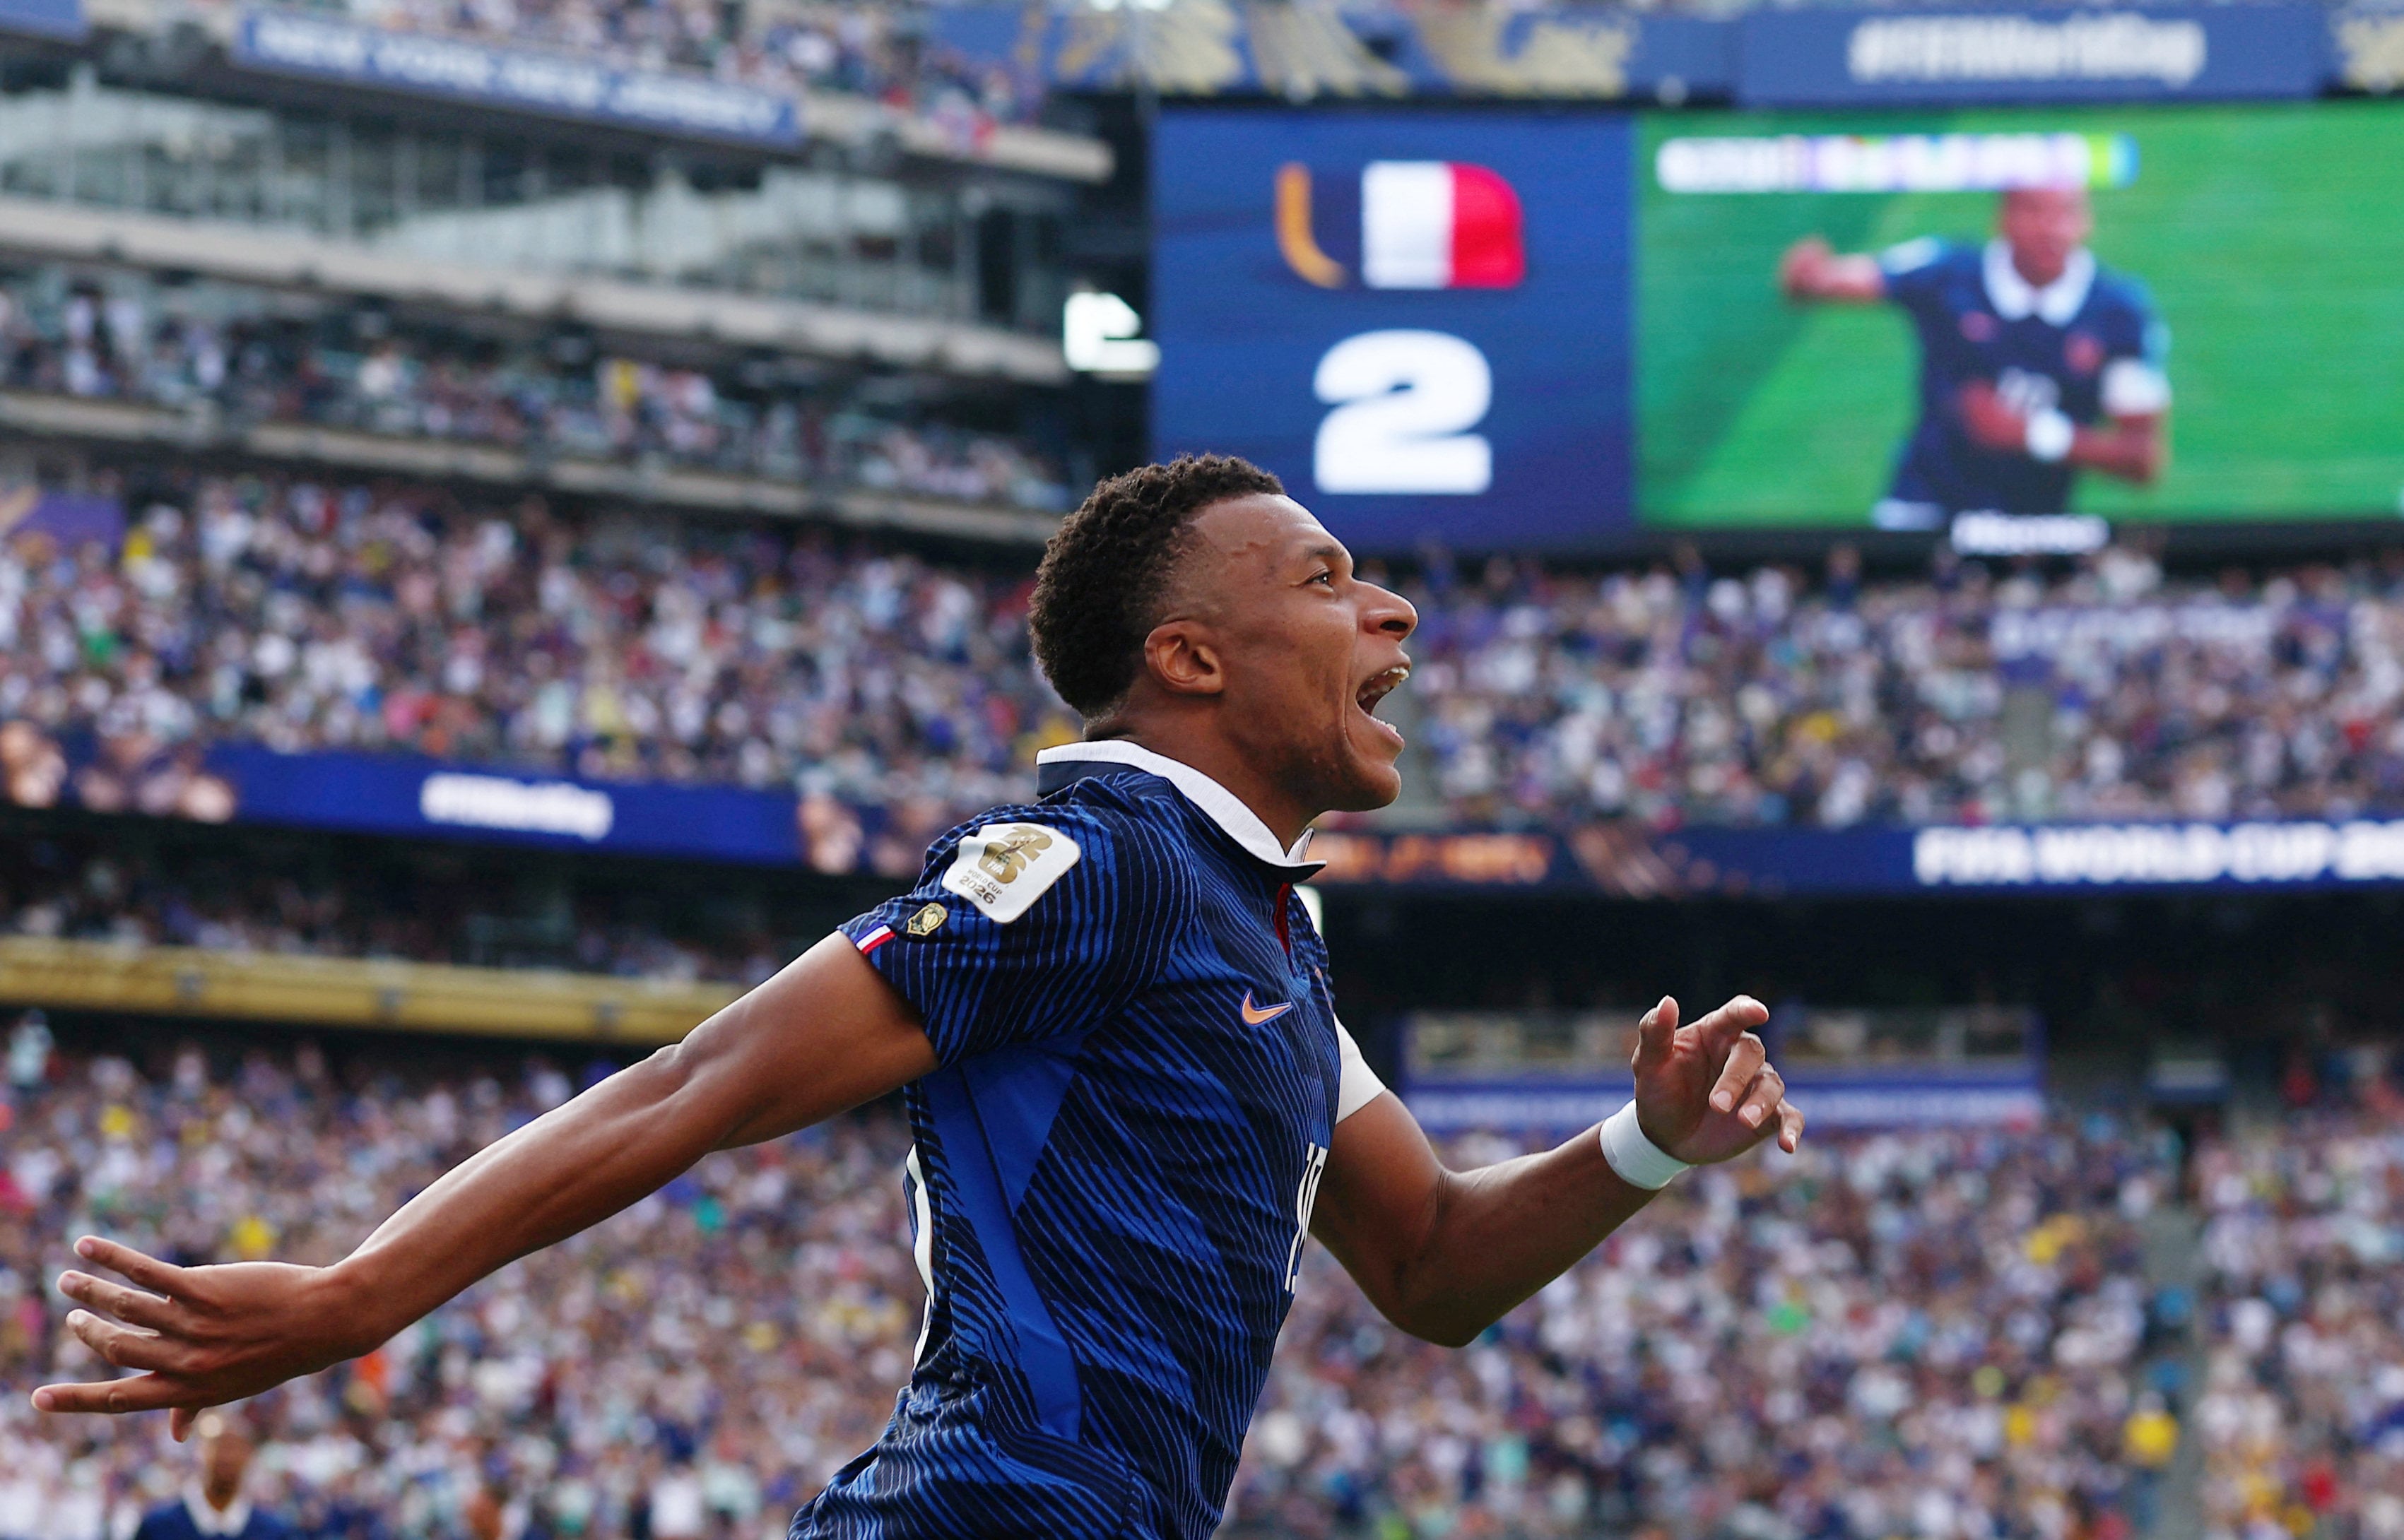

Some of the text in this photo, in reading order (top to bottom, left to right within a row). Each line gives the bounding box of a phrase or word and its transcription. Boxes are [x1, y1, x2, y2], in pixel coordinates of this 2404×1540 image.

[1314, 329, 1491, 494] 2
[986, 860, 1006, 876] FIFA
[1916, 828, 2031, 884] FIFA
[2035, 825, 2225, 882] WORLD
[2229, 823, 2332, 881] CUP
[959, 875, 997, 905] 2026
[967, 869, 1003, 895] WORLD CUP
